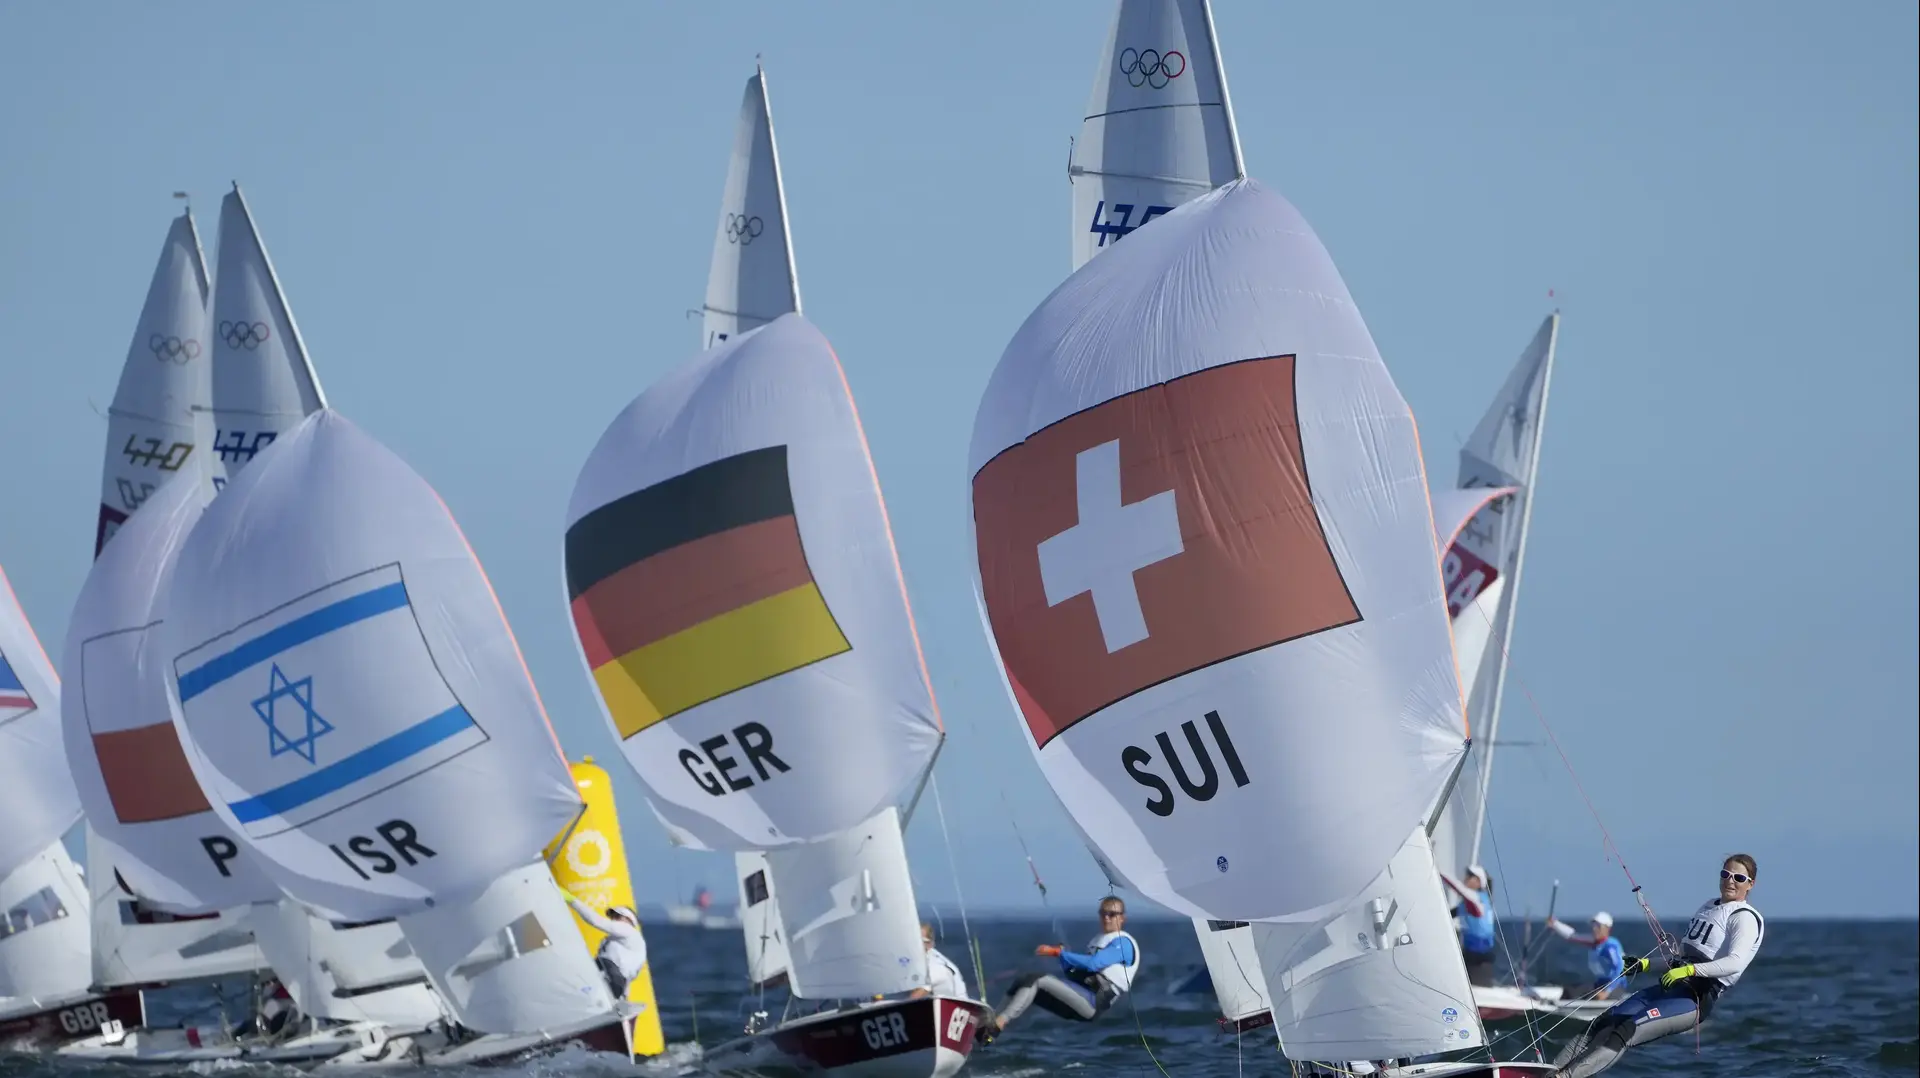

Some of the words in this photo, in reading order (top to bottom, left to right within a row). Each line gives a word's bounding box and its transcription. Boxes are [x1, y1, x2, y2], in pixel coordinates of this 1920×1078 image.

[122, 433, 195, 471] 470
[678, 721, 792, 797] GER
[1121, 709, 1250, 817] SUI
[199, 835, 238, 877] P
[328, 819, 437, 881] ISR
[59, 1001, 109, 1034] GBR
[861, 1011, 909, 1050] GER
